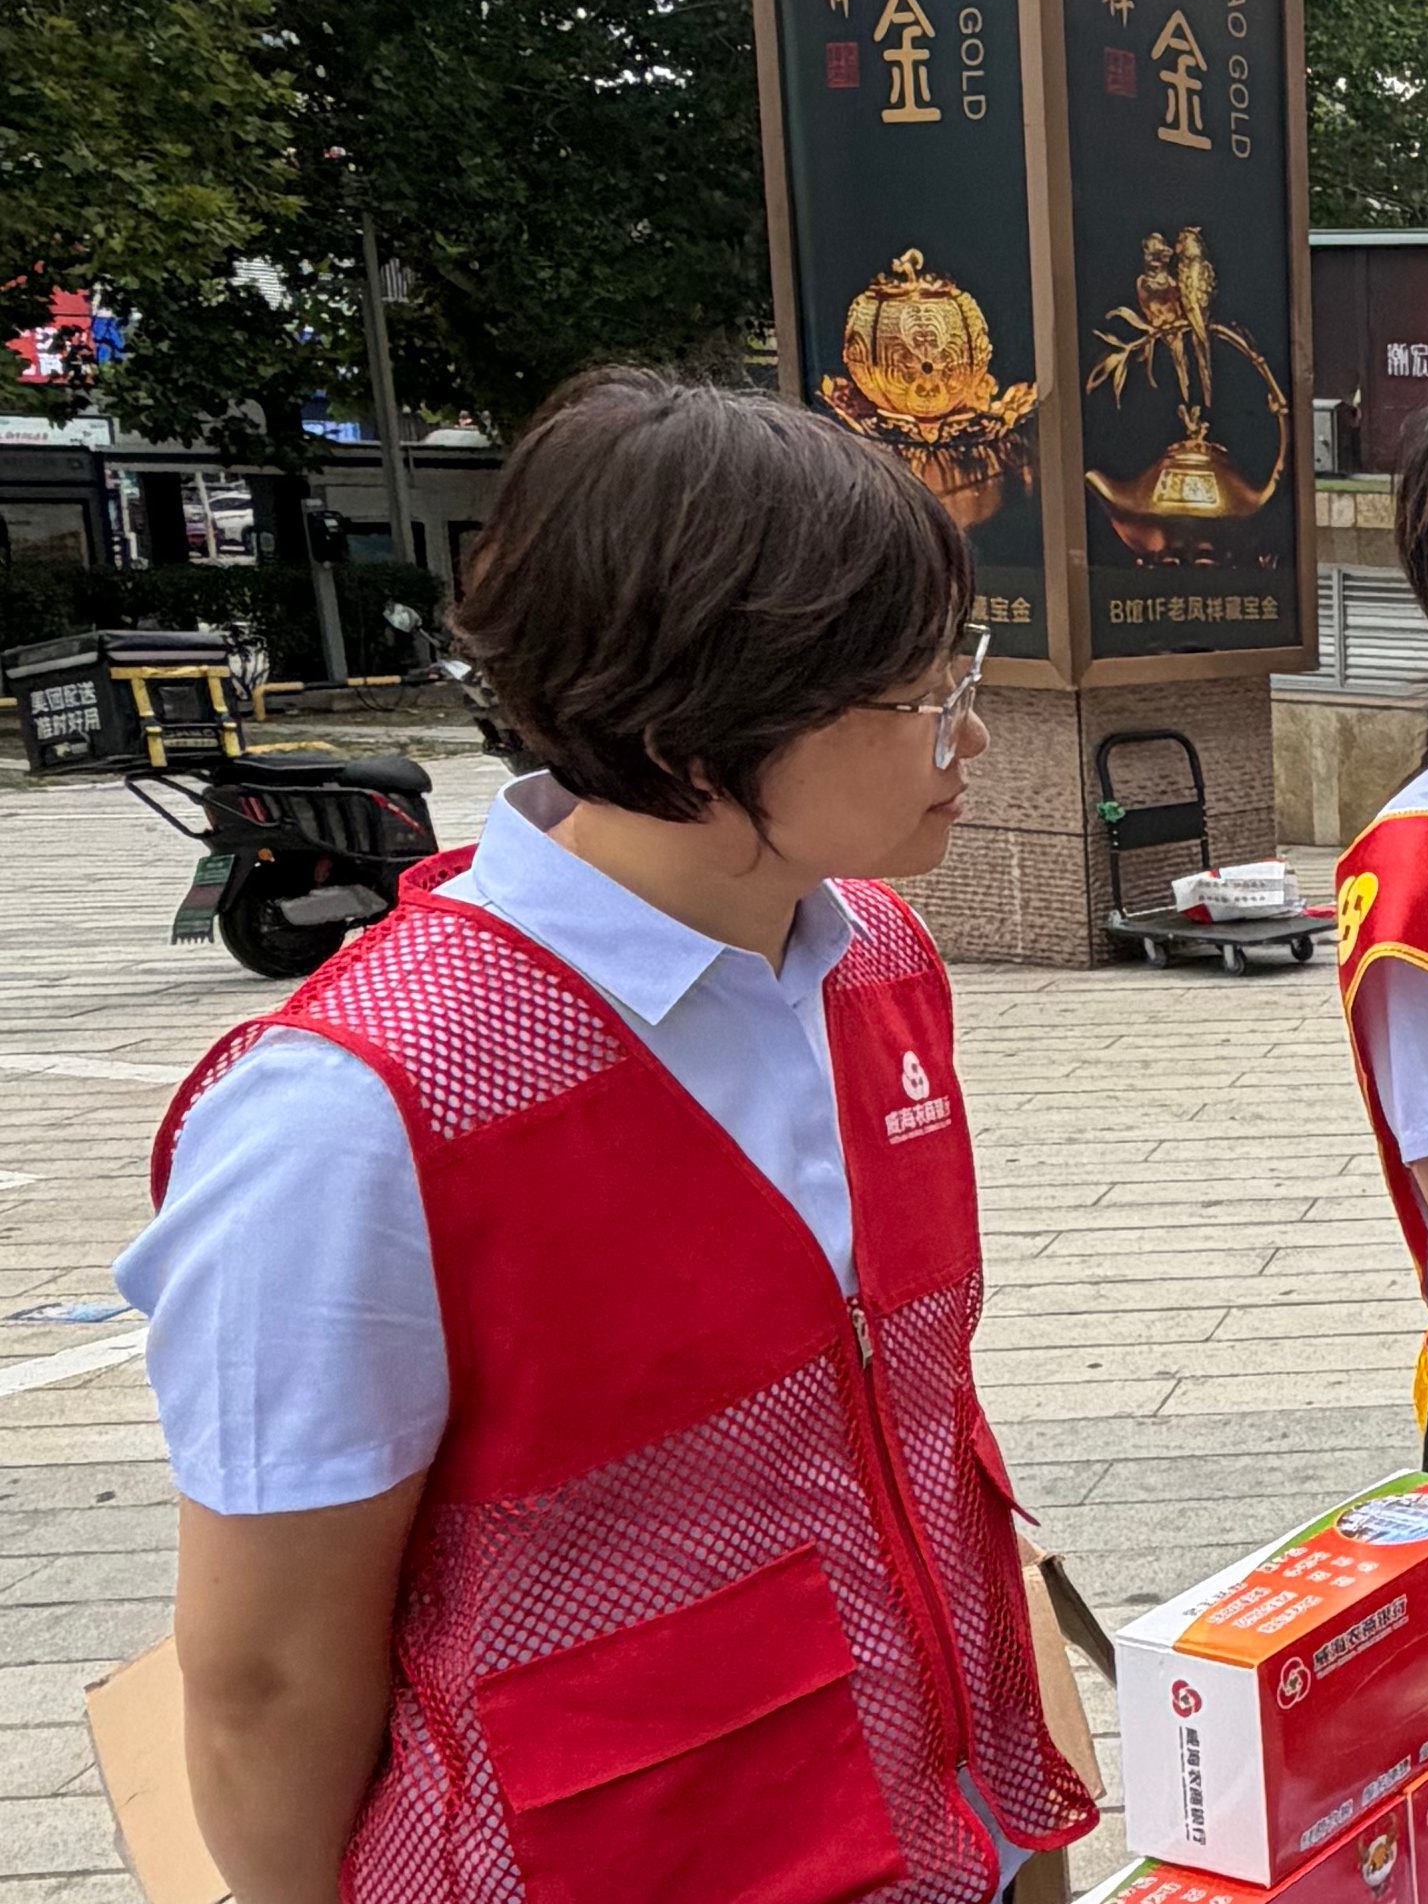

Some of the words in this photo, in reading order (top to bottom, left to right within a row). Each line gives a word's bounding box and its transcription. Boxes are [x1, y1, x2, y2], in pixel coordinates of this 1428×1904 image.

[955, 7, 988, 121] GOLD
[1226, 54, 1252, 160] GOLD
[1109, 596, 1279, 625] B馆1F老凤祥藏宝金
